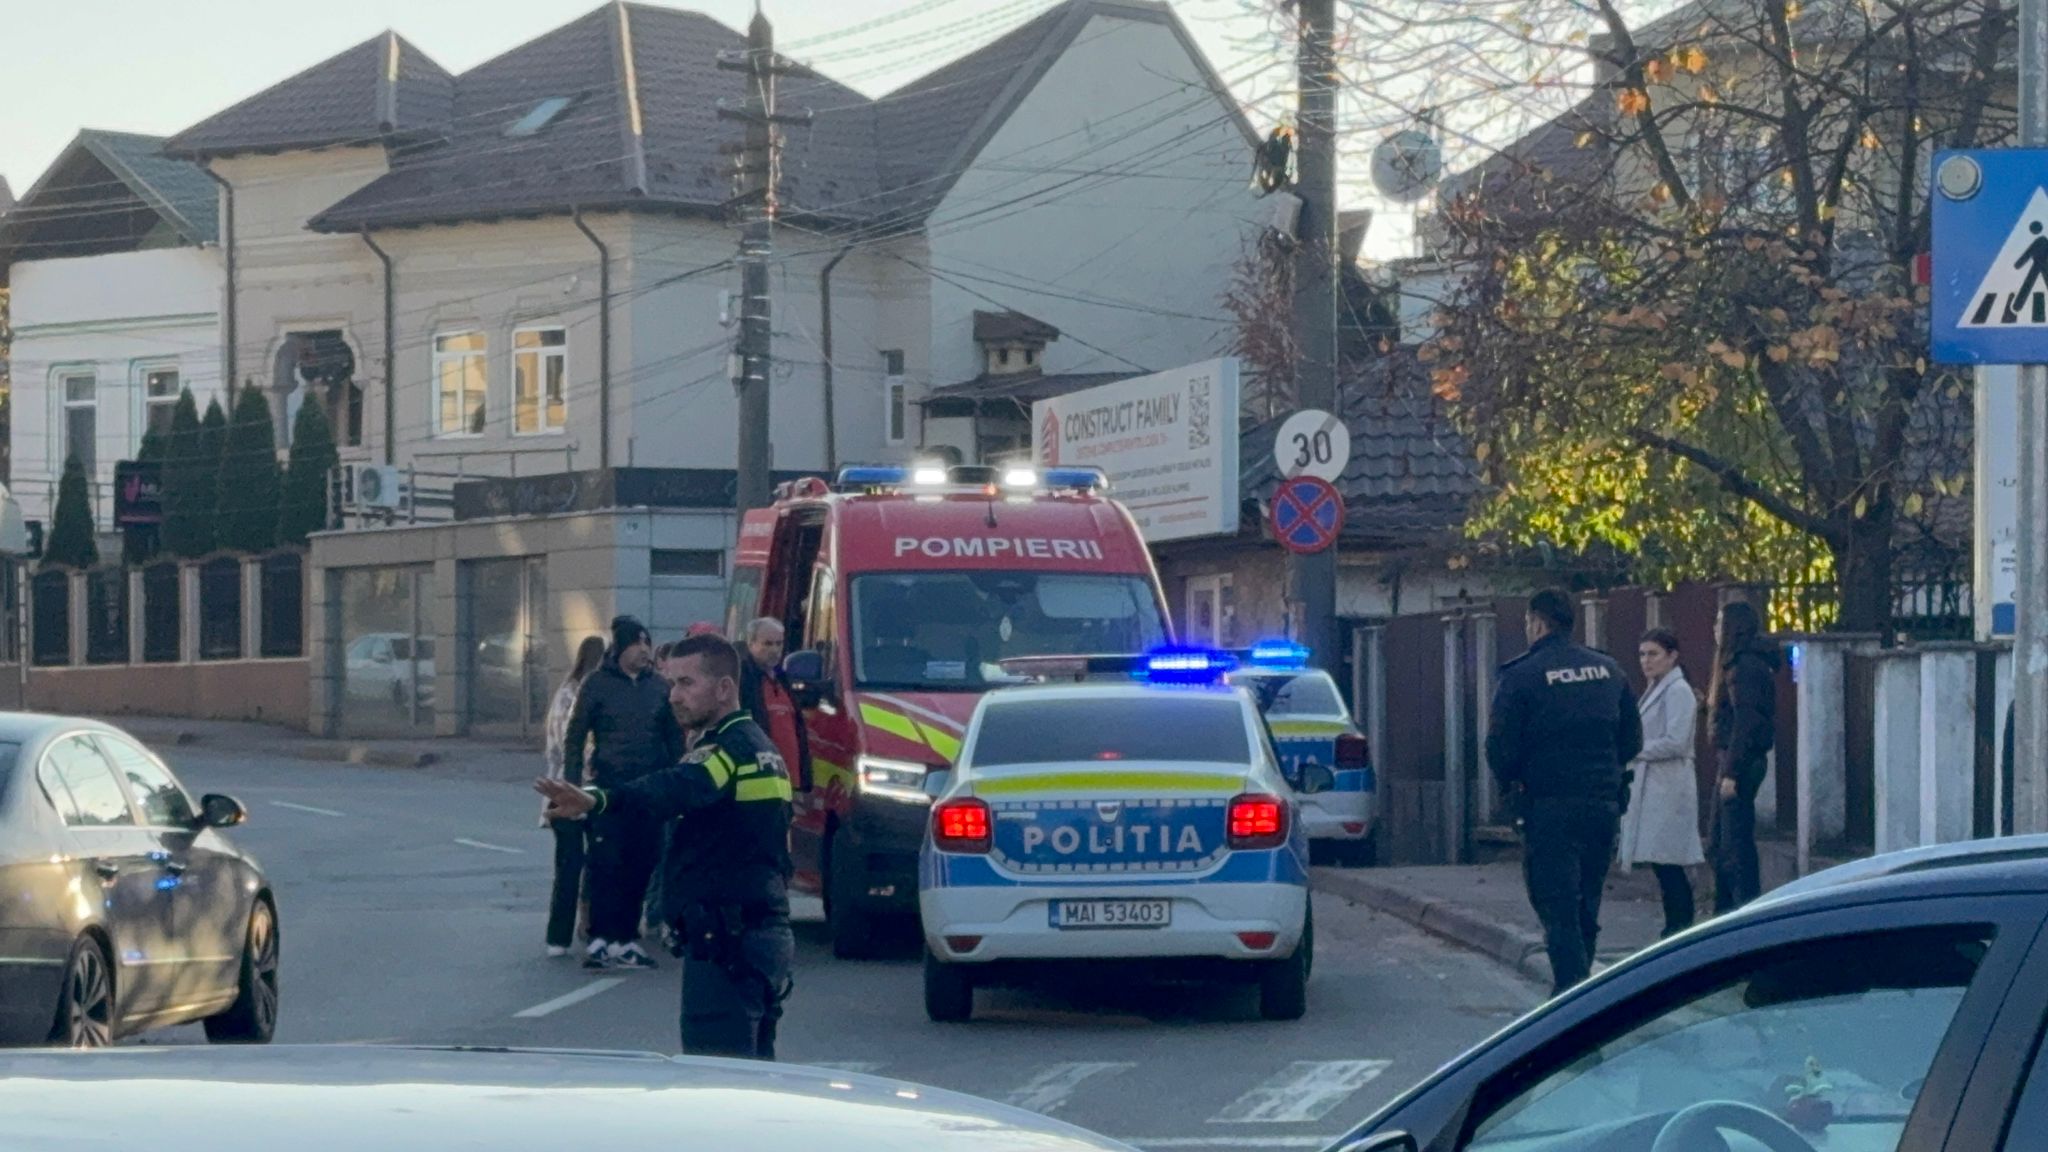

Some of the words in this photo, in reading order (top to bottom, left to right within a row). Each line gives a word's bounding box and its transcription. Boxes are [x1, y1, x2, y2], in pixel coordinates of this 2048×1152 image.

[1065, 401, 1133, 442] CONSTRUCT
[1136, 392, 1180, 429] FAMILY
[1293, 430, 1332, 467] 30
[895, 537, 1103, 560] POMPIERII
[1024, 825, 1202, 854] POLITIA
[1066, 902, 1096, 922] MAI
[1104, 902, 1164, 922] 53403
